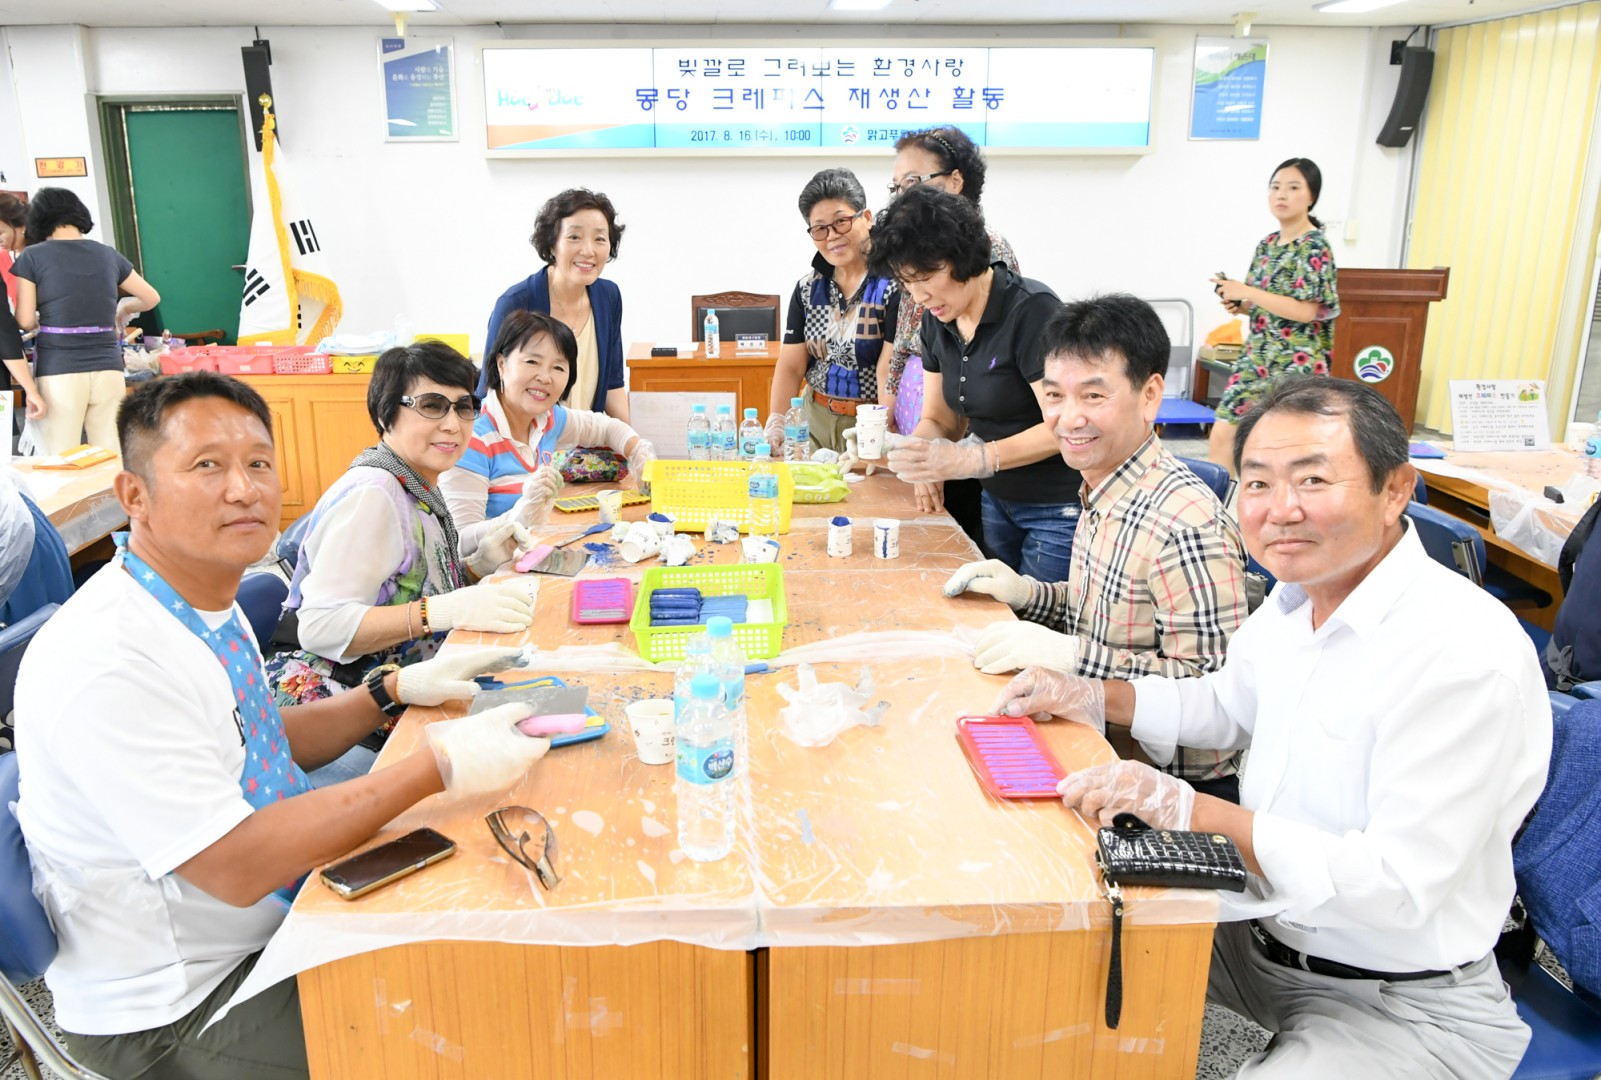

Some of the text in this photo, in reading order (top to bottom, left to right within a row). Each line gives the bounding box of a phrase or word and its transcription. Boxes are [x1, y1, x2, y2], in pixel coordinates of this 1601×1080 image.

[679, 58, 746, 77] 빛깔로
[873, 57, 964, 78] 환경사랑
[636, 88, 691, 111] 몽당
[848, 87, 932, 110] 재생산
[952, 86, 1005, 110] 활동
[690, 129, 718, 142] 2017.
[723, 129, 733, 142] 8.
[784, 129, 811, 141] 10:00
